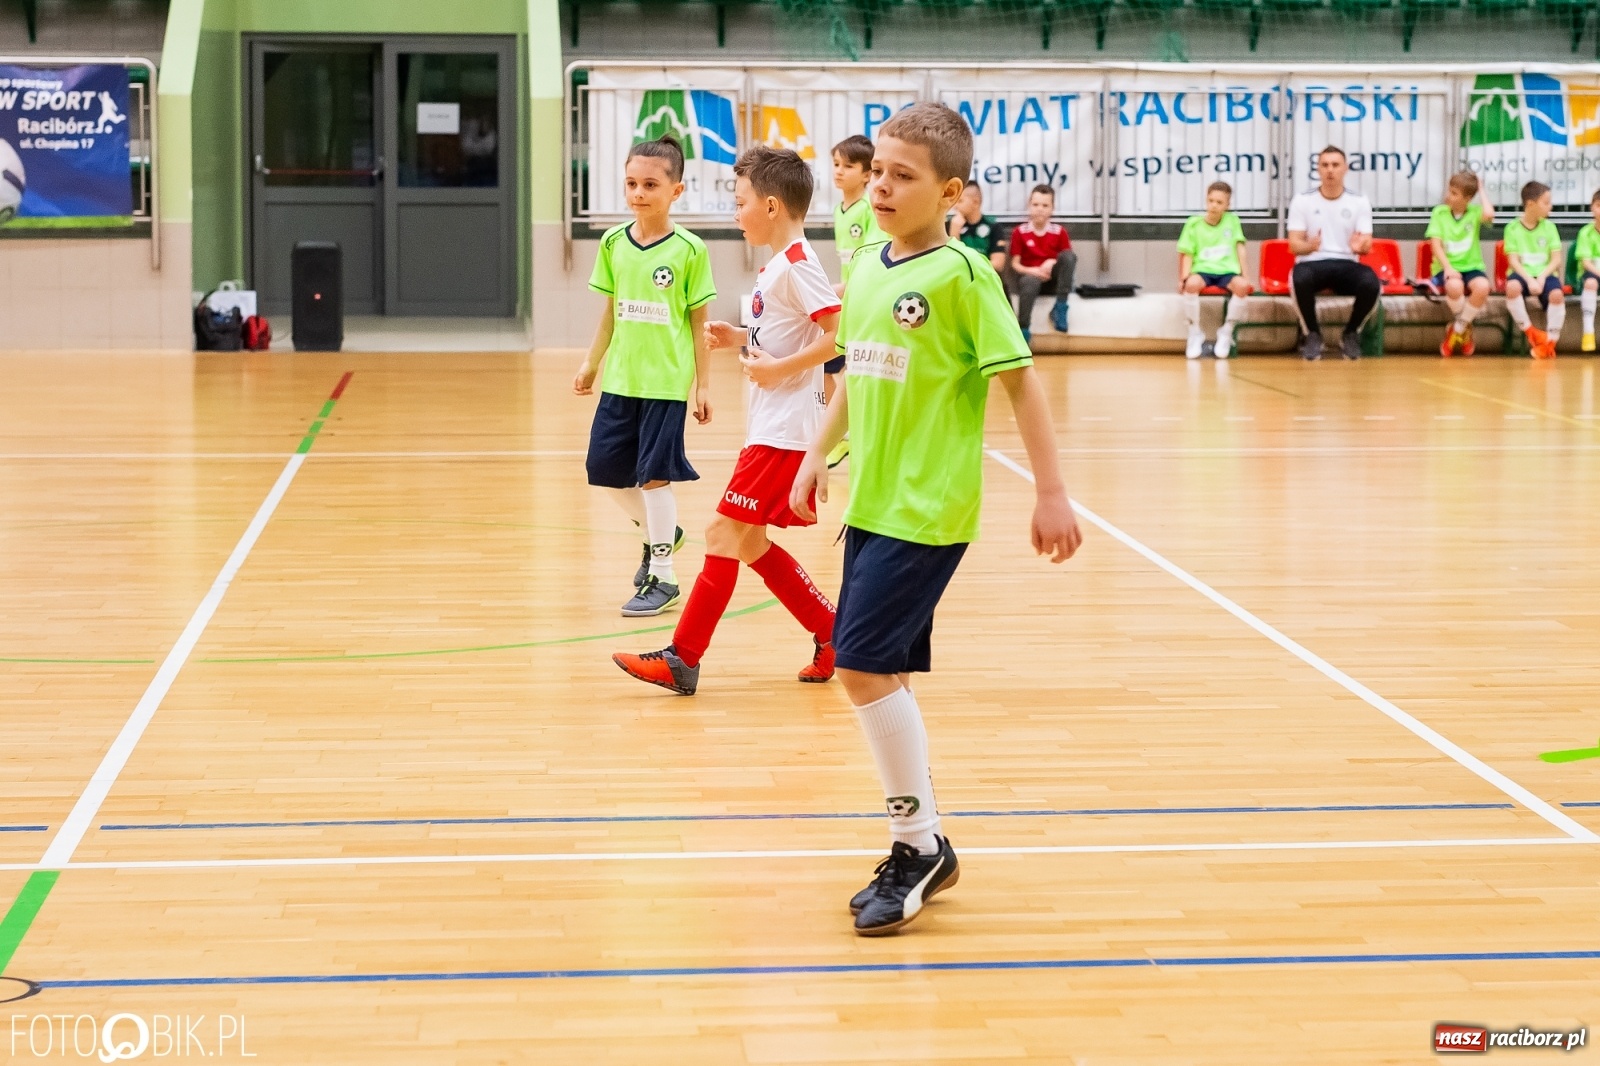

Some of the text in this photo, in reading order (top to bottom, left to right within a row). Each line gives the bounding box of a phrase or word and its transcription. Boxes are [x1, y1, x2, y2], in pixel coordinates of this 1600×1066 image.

[21, 91, 96, 110] SPORT
[864, 85, 1419, 140] PWIAT RACIBORSKI
[17, 116, 95, 135] Racibórz
[80, 138, 95, 150] 17
[1308, 150, 1424, 182] gamy
[627, 304, 669, 317] BAUMAG
[725, 490, 759, 511] CMYK
